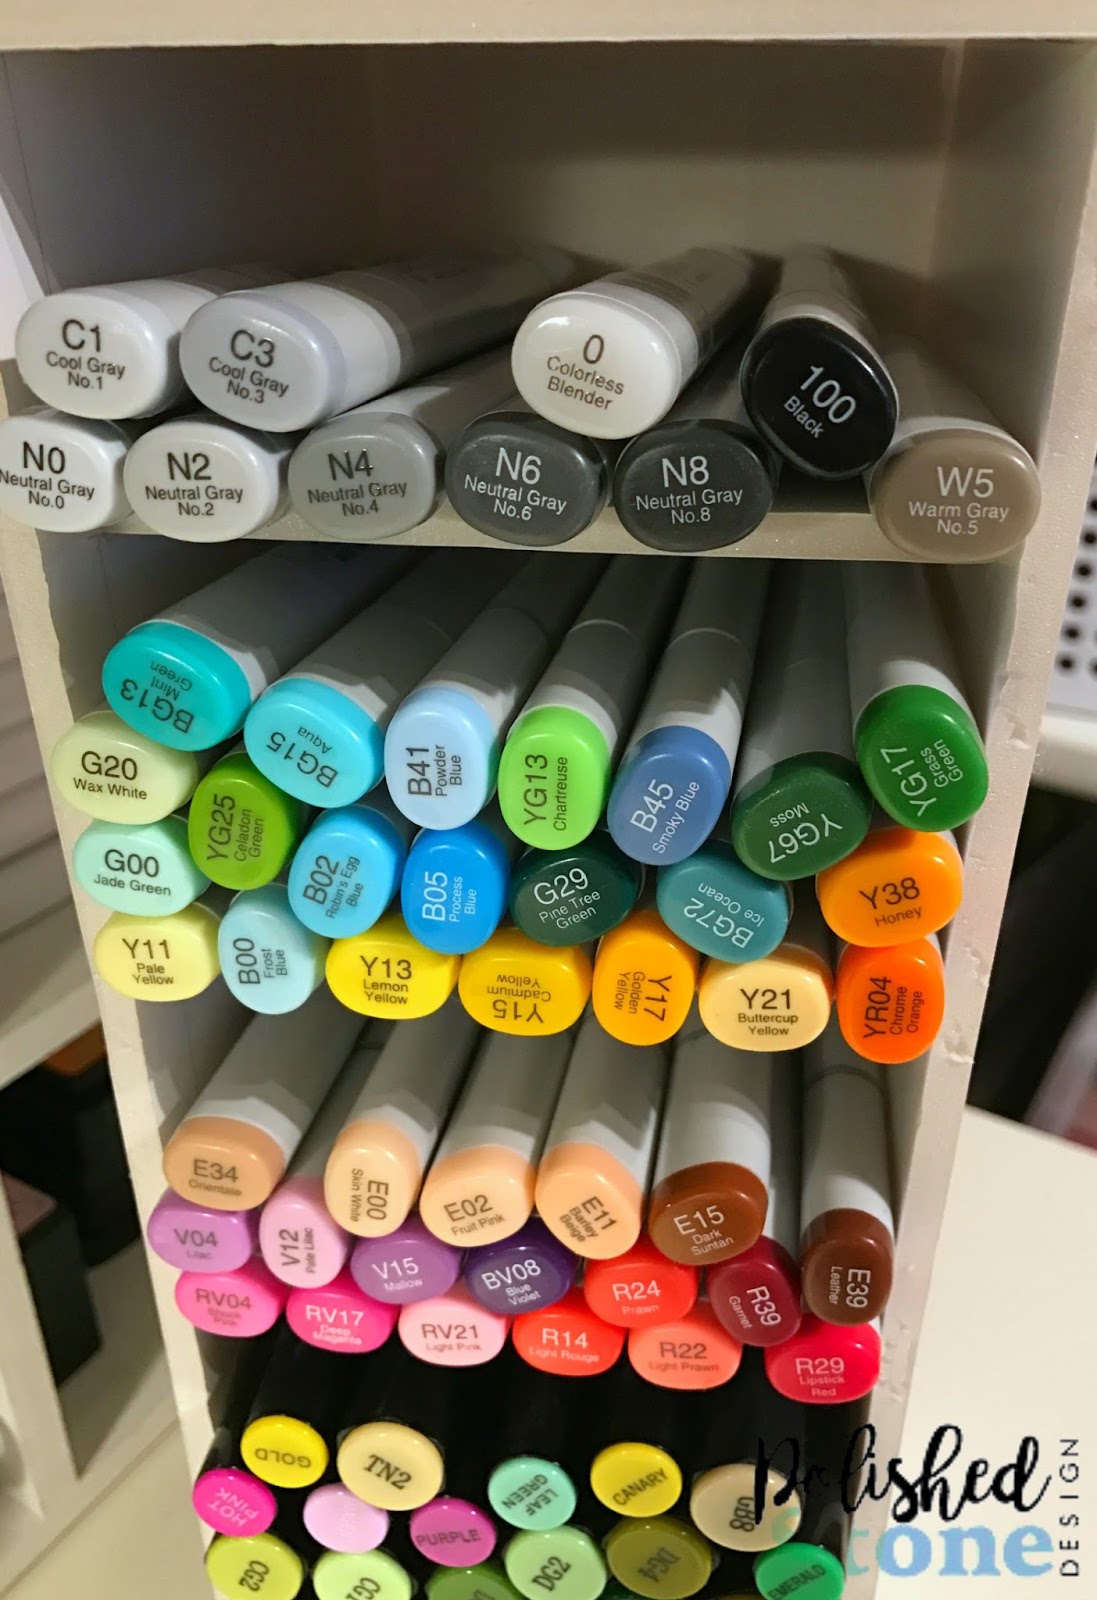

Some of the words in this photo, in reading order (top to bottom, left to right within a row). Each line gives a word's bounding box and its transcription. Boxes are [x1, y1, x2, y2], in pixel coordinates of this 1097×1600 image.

[62, 319, 101, 351] C1
[231, 329, 275, 369] C3
[583, 334, 605, 365] 0
[46, 351, 82, 371] Cool
[87, 357, 125, 381] Gray
[68, 372, 104, 390] No.1
[209, 357, 245, 381] Cool
[249, 370, 289, 397] Gray
[546, 355, 625, 395] Colorless
[227, 380, 265, 404] No.3
[547, 375, 613, 411] Blender
[800, 365, 857, 425] 100
[784, 395, 825, 438] Black
[22, 442, 66, 474] N0
[167, 452, 211, 481] N2
[328, 450, 374, 481] N4
[495, 448, 542, 485] N6
[662, 456, 709, 487] N8
[0, 469, 52, 491] Neutral
[58, 480, 95, 501] Gray
[145, 485, 195, 501] Neutral
[200, 486, 243, 503] Gray
[308, 485, 365, 504] Neutral
[369, 481, 407, 499] Gray
[464, 474, 529, 504] Neutral
[533, 489, 568, 514] Gray
[937, 466, 994, 498] W5
[29, 491, 64, 509] No.0
[178, 502, 214, 516] No.2
[342, 500, 379, 516] No.4
[493, 498, 532, 521] No.6
[636, 491, 697, 511] Neutral
[702, 488, 744, 507] Gray
[908, 502, 962, 518] Warm
[966, 503, 1009, 522] Gray
[671, 507, 711, 523] No.8
[937, 520, 978, 534] No.5
[150, 660, 194, 691] Green
[150, 677, 180, 701] Mint
[121, 678, 195, 734] BG13
[297, 726, 333, 752] Aqua
[81, 750, 137, 780] G20
[266, 731, 338, 787] BG15
[407, 748, 432, 796] B41
[435, 744, 447, 797] Powder
[450, 755, 462, 786] Blue
[920, 747, 948, 787] Grass
[933, 739, 963, 782] Green
[73, 778, 103, 793] Wax
[108, 781, 147, 800] White
[524, 754, 548, 826] YG13
[553, 756, 568, 831] Chartreuse
[880, 746, 937, 817] YG17
[630, 779, 674, 833] B45
[652, 812, 686, 854] Smoky
[676, 781, 700, 812] Blue
[770, 802, 809, 827] Moss
[207, 794, 235, 861] YG25
[234, 808, 252, 861] Celadon
[249, 818, 264, 858] Green
[769, 814, 843, 864] YG67
[104, 849, 160, 877] G00
[341, 857, 360, 879] Egg
[94, 874, 125, 892] Jade
[129, 879, 171, 896] Green
[303, 855, 339, 905] B02
[346, 883, 364, 907] Blue
[534, 868, 588, 905] G29
[859, 877, 920, 911] Y38
[422, 872, 448, 922] B05
[449, 876, 463, 922] Process
[464, 888, 477, 914] Blue
[539, 902, 567, 923] Pine
[567, 890, 601, 908] Tree
[698, 882, 741, 915] Ocean
[555, 906, 596, 929] Green
[683, 897, 754, 949] BG72
[744, 908, 765, 926] Ice
[875, 907, 923, 927] Honey
[122, 939, 170, 959] Y11
[233, 938, 260, 985] B00
[263, 948, 274, 978] Frost
[275, 949, 288, 975] Blue
[132, 974, 174, 985] Yellow
[136, 963, 165, 974] Pale
[360, 956, 412, 980] Y13
[496, 974, 539, 987] Yellow
[363, 979, 409, 993] Lemon
[366, 991, 409, 1005] Yellow
[487, 986, 551, 1002] Cadmium
[614, 971, 631, 1011] Yellow
[628, 970, 646, 1014] Golden
[645, 974, 672, 1022] Y17
[740, 989, 791, 1009] Y21
[492, 1000, 543, 1023] Y15
[738, 1012, 798, 1025] Buttercup
[863, 977, 892, 1038] YR04
[890, 986, 907, 1035] Chrome
[907, 991, 923, 1033] Orange
[748, 1025, 789, 1036] Yellow
[194, 1158, 238, 1182] E34
[351, 1168, 363, 1191] Skin
[350, 1194, 363, 1222] White
[367, 1179, 389, 1221] E00
[444, 1195, 493, 1222] E02
[580, 1195, 617, 1233] E11
[451, 1219, 477, 1236] Fruit
[479, 1213, 505, 1228] Pink
[559, 1212, 586, 1243] Beige
[569, 1203, 598, 1237] Barley
[673, 1206, 725, 1236] E15
[173, 1229, 218, 1247] V04
[282, 1229, 299, 1266] V12
[690, 1235, 734, 1256] Suntan
[693, 1229, 722, 1244] Dark
[372, 1258, 419, 1279] V15
[482, 1259, 541, 1290] BV08
[195, 1288, 251, 1310] RV04
[505, 1284, 532, 1297] Blue
[508, 1290, 541, 1306] Violet
[612, 1280, 661, 1301] R24
[828, 1266, 843, 1305] Leather
[847, 1268, 871, 1309] E39
[305, 1305, 364, 1326] RV17
[729, 1296, 753, 1329] Garnet
[746, 1286, 781, 1327] R39
[421, 1324, 479, 1339] RV21
[542, 1329, 589, 1348] R14
[659, 1342, 707, 1359] R22
[795, 1358, 844, 1375] R29
[799, 1375, 844, 1385] Lipstick
[811, 1387, 836, 1397] Red
[255, 1447, 312, 1468] GOLD
[363, 1454, 412, 1490] TN2
[502, 1473, 548, 1510] GREEN
[525, 1488, 559, 1516] LEAF
[612, 1468, 669, 1506] CANARY
[208, 1501, 249, 1527] HOT
[216, 1487, 259, 1520] PINK
[416, 1529, 480, 1546] PURPLE
[238, 1560, 270, 1591] CG2
[532, 1556, 571, 1591] DG2
